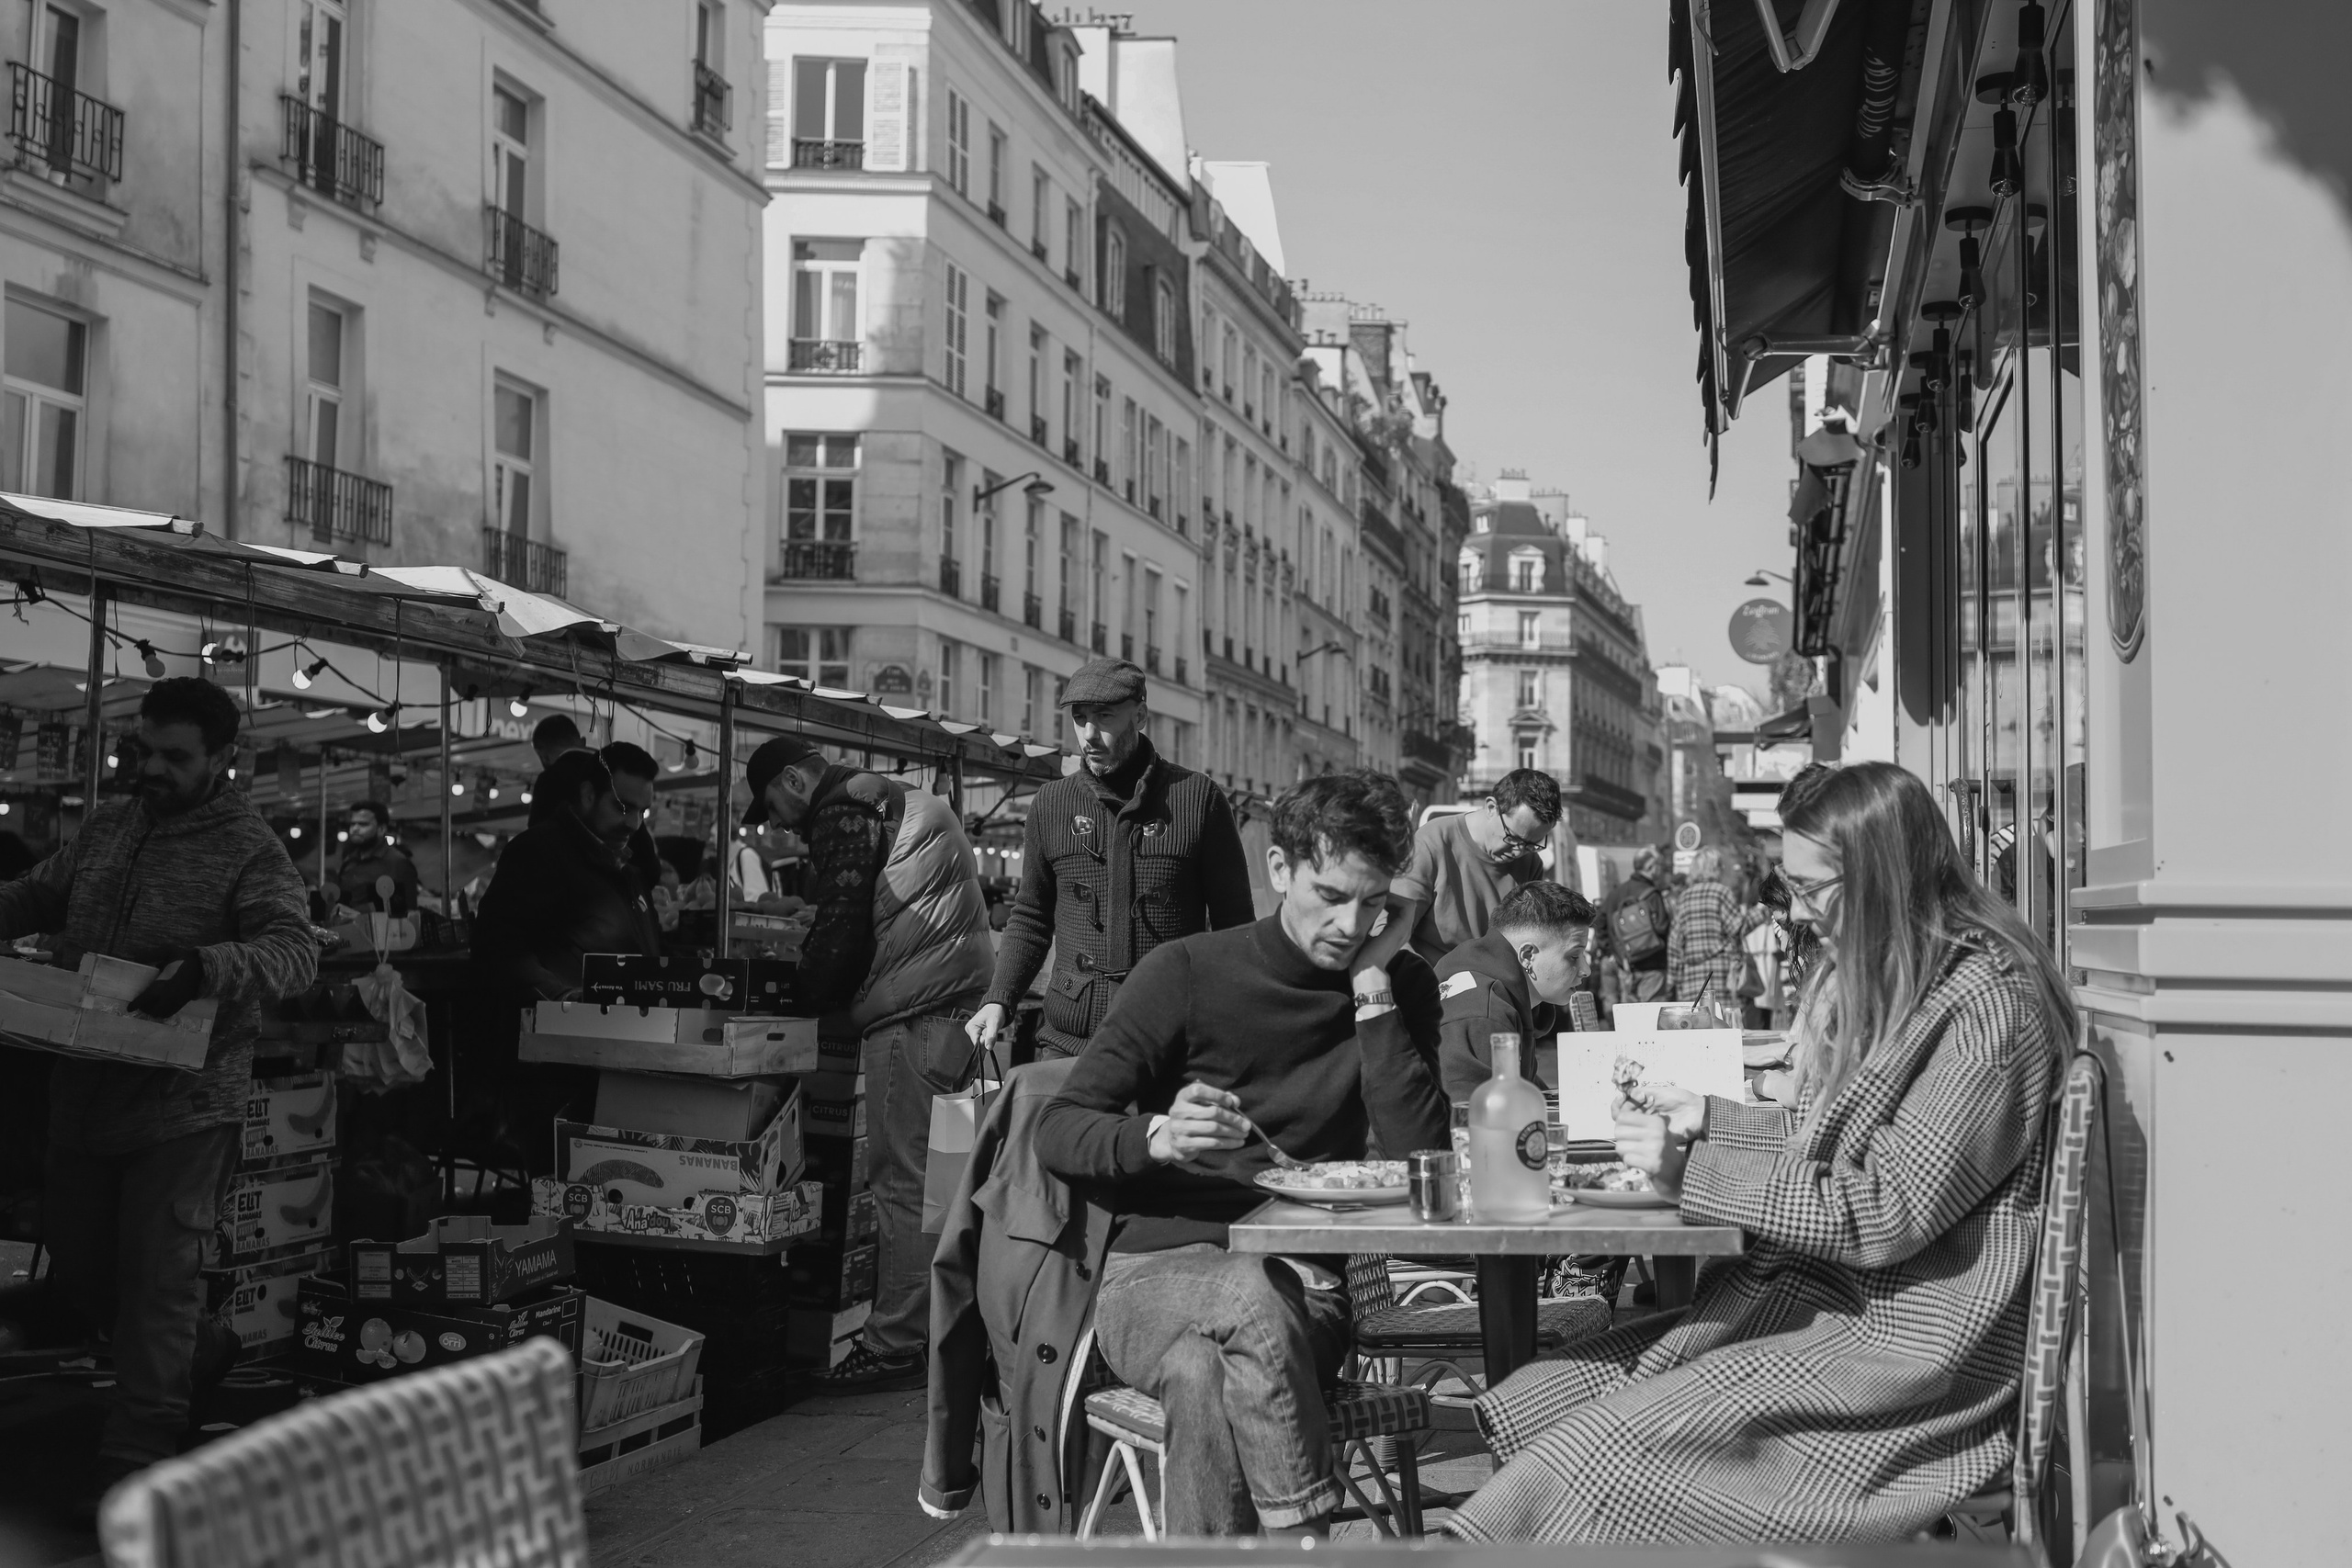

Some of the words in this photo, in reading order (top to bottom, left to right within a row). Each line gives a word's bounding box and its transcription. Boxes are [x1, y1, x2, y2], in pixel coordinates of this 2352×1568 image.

[634, 980, 664, 991] SAMI
[667, 981, 691, 992] FRU
[820, 1041, 856, 1053] CITRUS
[812, 1105, 849, 1117] CITRUS
[246, 1145, 278, 1158] BANANAS
[679, 1155, 739, 1171] BANANAS
[568, 1193, 588, 1202] SCB
[711, 1204, 731, 1214] SCB
[236, 1237, 270, 1252] BANANAS
[514, 1249, 557, 1278] YAMAMA
[535, 1305, 561, 1319] Mandarine
[304, 1335, 338, 1352] Citrus
[628, 1445, 682, 1475] NORMANDIE
